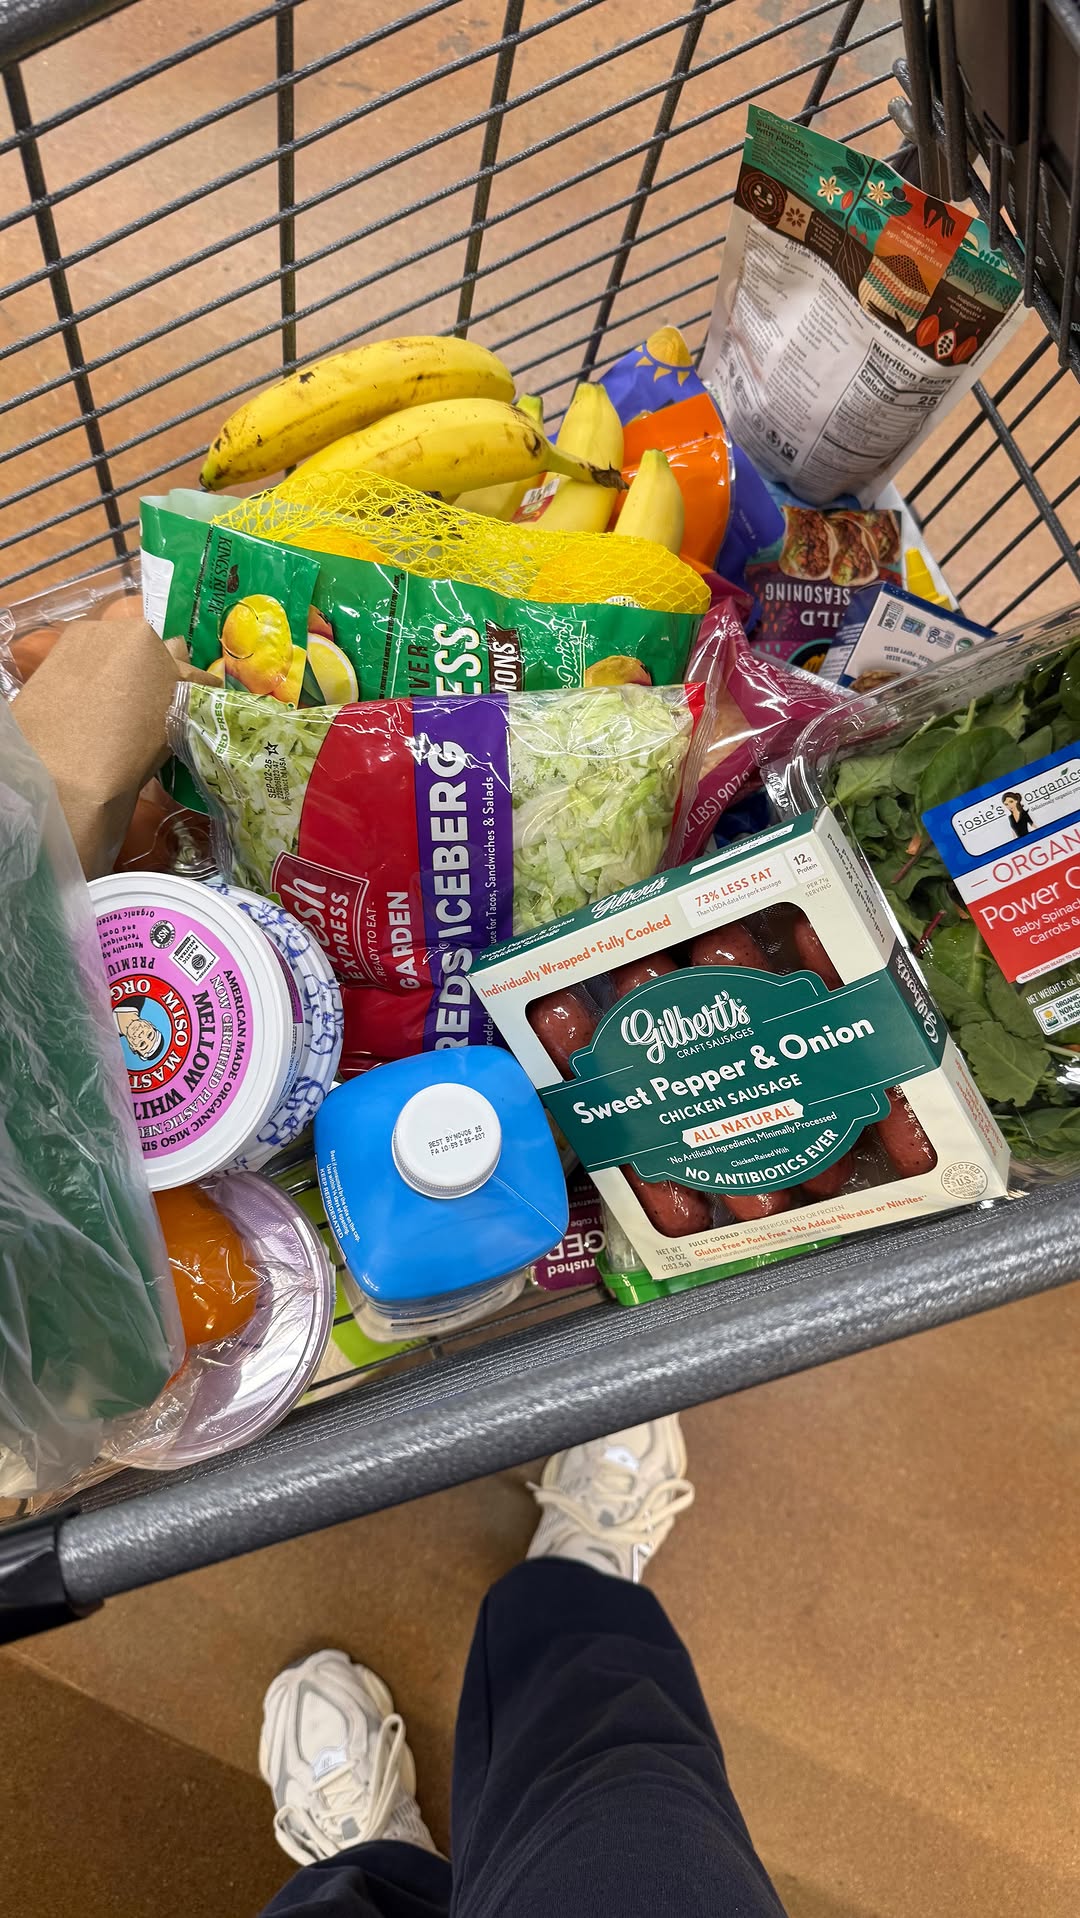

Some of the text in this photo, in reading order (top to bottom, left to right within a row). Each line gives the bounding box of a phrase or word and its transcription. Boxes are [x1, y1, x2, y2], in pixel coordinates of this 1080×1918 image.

[756, 126, 774, 140] with
[871, 342, 953, 387] Nutrition Facts
[859, 368, 940, 406] Calories 25
[207, 535, 233, 618] KINGS RIVER
[765, 583, 851, 607] SEASONING
[800, 610, 846, 628] ILD
[408, 644, 431, 697] VER
[433, 622, 482, 697] ESS
[482, 776, 494, 815] Salads
[957, 767, 1080, 837] josie's organics
[482, 817, 494, 826] &
[692, 796, 722, 826] LBS)
[428, 741, 472, 939] ICEBERG
[483, 829, 498, 889] Sandwiches
[792, 852, 813, 867] 12g
[796, 862, 819, 876] Protein
[591, 875, 670, 919] Gilbert's
[694, 866, 773, 908] 73% LESS FAT
[696, 879, 783, 918] Than USDA data for pork sausage
[804, 882, 833, 901] SERVING
[806, 884, 819, 893] PER
[123, 908, 155, 918] Organic
[484, 889, 499, 918] Tacos,
[978, 881, 1061, 931] Power
[121, 924, 137, 934] and
[158, 927, 171, 943] NSF
[329, 892, 366, 980] EXPRESS
[486, 917, 497, 931] for
[1012, 918, 1042, 938] Baby
[1029, 920, 1072, 945] Carrots
[111, 942, 144, 956] Naturally
[366, 908, 387, 977] READY TO EAT
[387, 890, 420, 992] GARDEN
[480, 914, 673, 998] Individually Wrapped Fully Cooked
[110, 979, 151, 1002] ORG
[1026, 993, 1040, 1006] NET
[1038, 982, 1063, 1001] WEIGHT
[1061, 979, 1067, 988] 5
[162, 989, 188, 1047] MISO
[620, 989, 751, 1064] Gilbert's
[134, 989, 215, 1121] MELLOW WHIT
[164, 973, 233, 1132] NOW CERTIFIED PLASTIC
[676, 1027, 755, 1059] CRAFT SAUSAGES
[161, 969, 247, 1148] AMERICAN MADE ORGANIC MISO
[572, 1018, 876, 1124] Sweet Pepper & Onion
[659, 1073, 803, 1125] CHICKEN SAUSAGE
[427, 1140, 444, 1150] BEST
[445, 1135, 454, 1144] BY
[682, 1111, 839, 1162] Artificial Ingredients, Minimally Processed
[693, 1127, 721, 1143] ALL
[430, 1148, 441, 1157] FA
[684, 1127, 840, 1186] NO ANTIBIOTICS EVER
[730, 1145, 791, 1169] Chicken Raised With
[943, 1163, 981, 1186] INSPECTED
[955, 1175, 975, 1187] U.S.
[320, 1168, 344, 1239] KEEP REFRIGERATED
[815, 1203, 846, 1217] FROZEN
[570, 1218, 593, 1228] cube
[693, 1203, 887, 1259] Gluten Free Pork Free No Added Nitrates or
[655, 1244, 683, 1257] NET WT
[688, 1231, 741, 1249] FULLY COOKED
[547, 1258, 596, 1278] rushed
[660, 1259, 693, 1273] (283.5g)
[664, 1252, 688, 1264] 10 OZ
